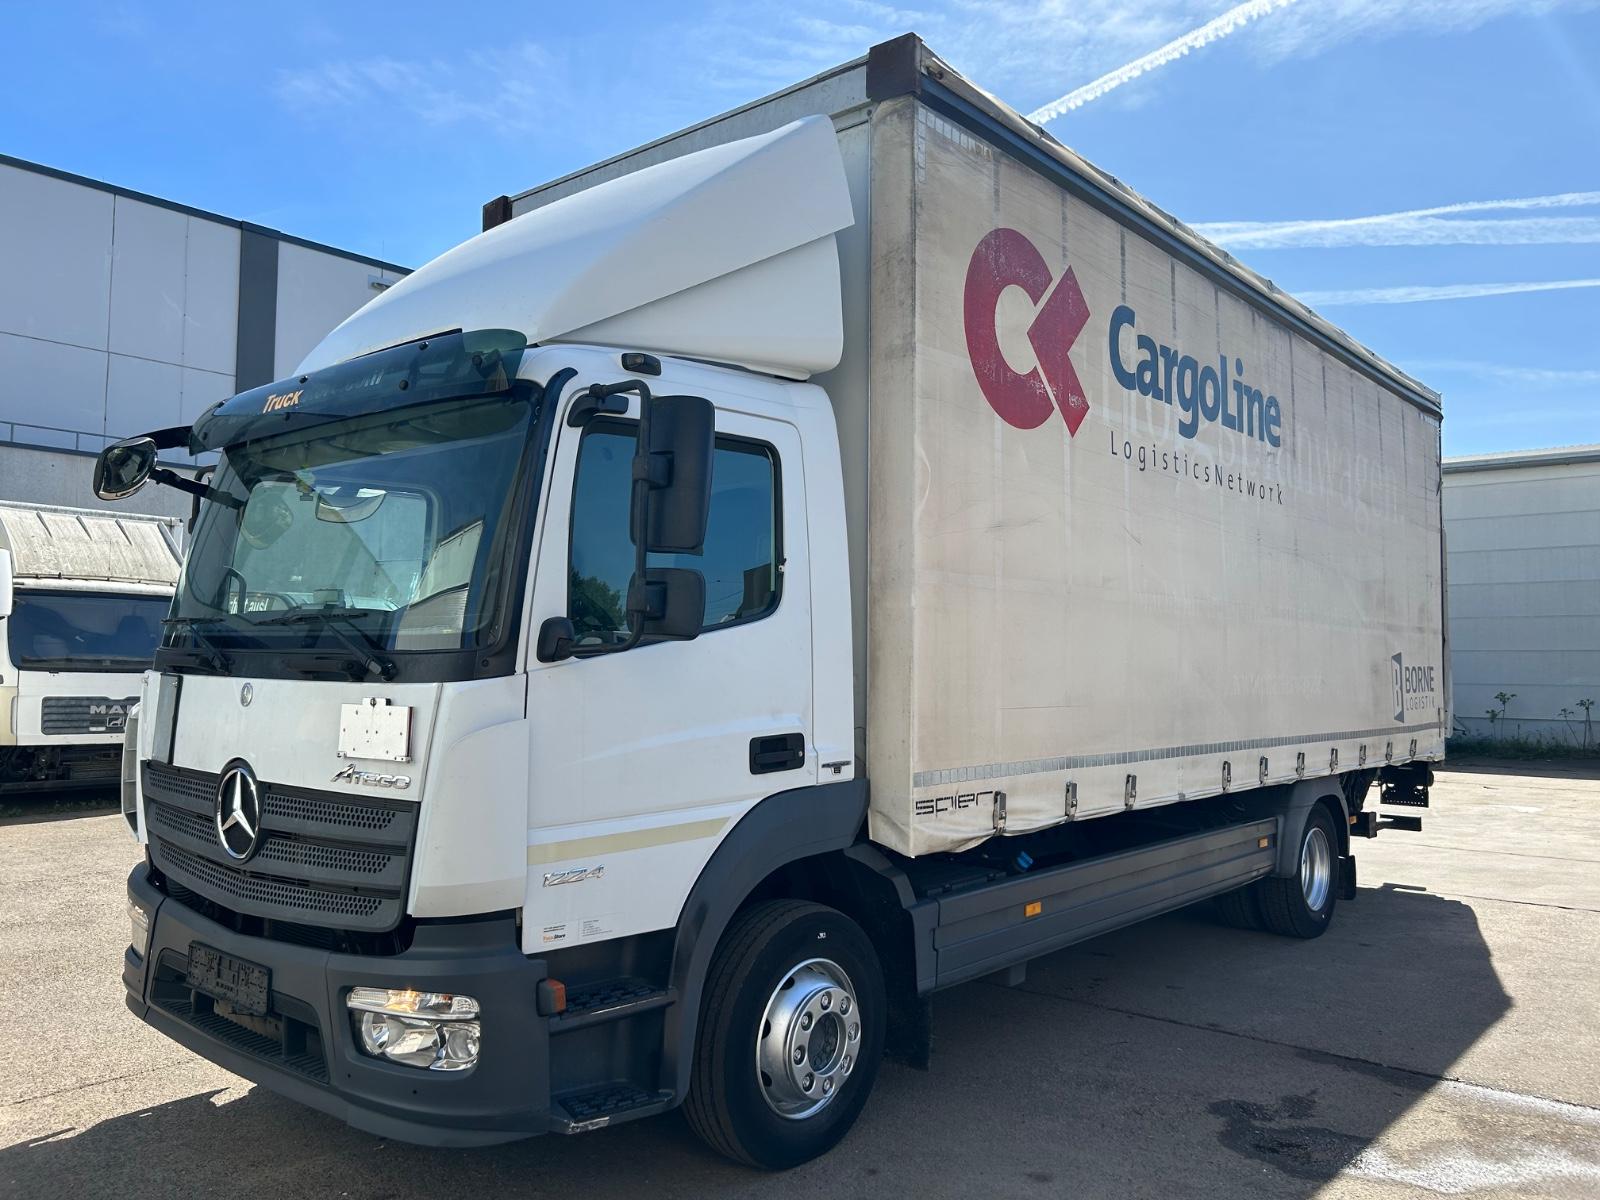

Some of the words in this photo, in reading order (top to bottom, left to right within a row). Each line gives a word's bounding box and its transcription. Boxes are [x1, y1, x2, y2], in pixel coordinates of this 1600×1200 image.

[1108, 304, 1282, 448] CargoLine
[1110, 430, 1283, 505] LogisticsNetwork
[1404, 666, 1435, 694] BORNE
[542, 864, 605, 888] 1224
